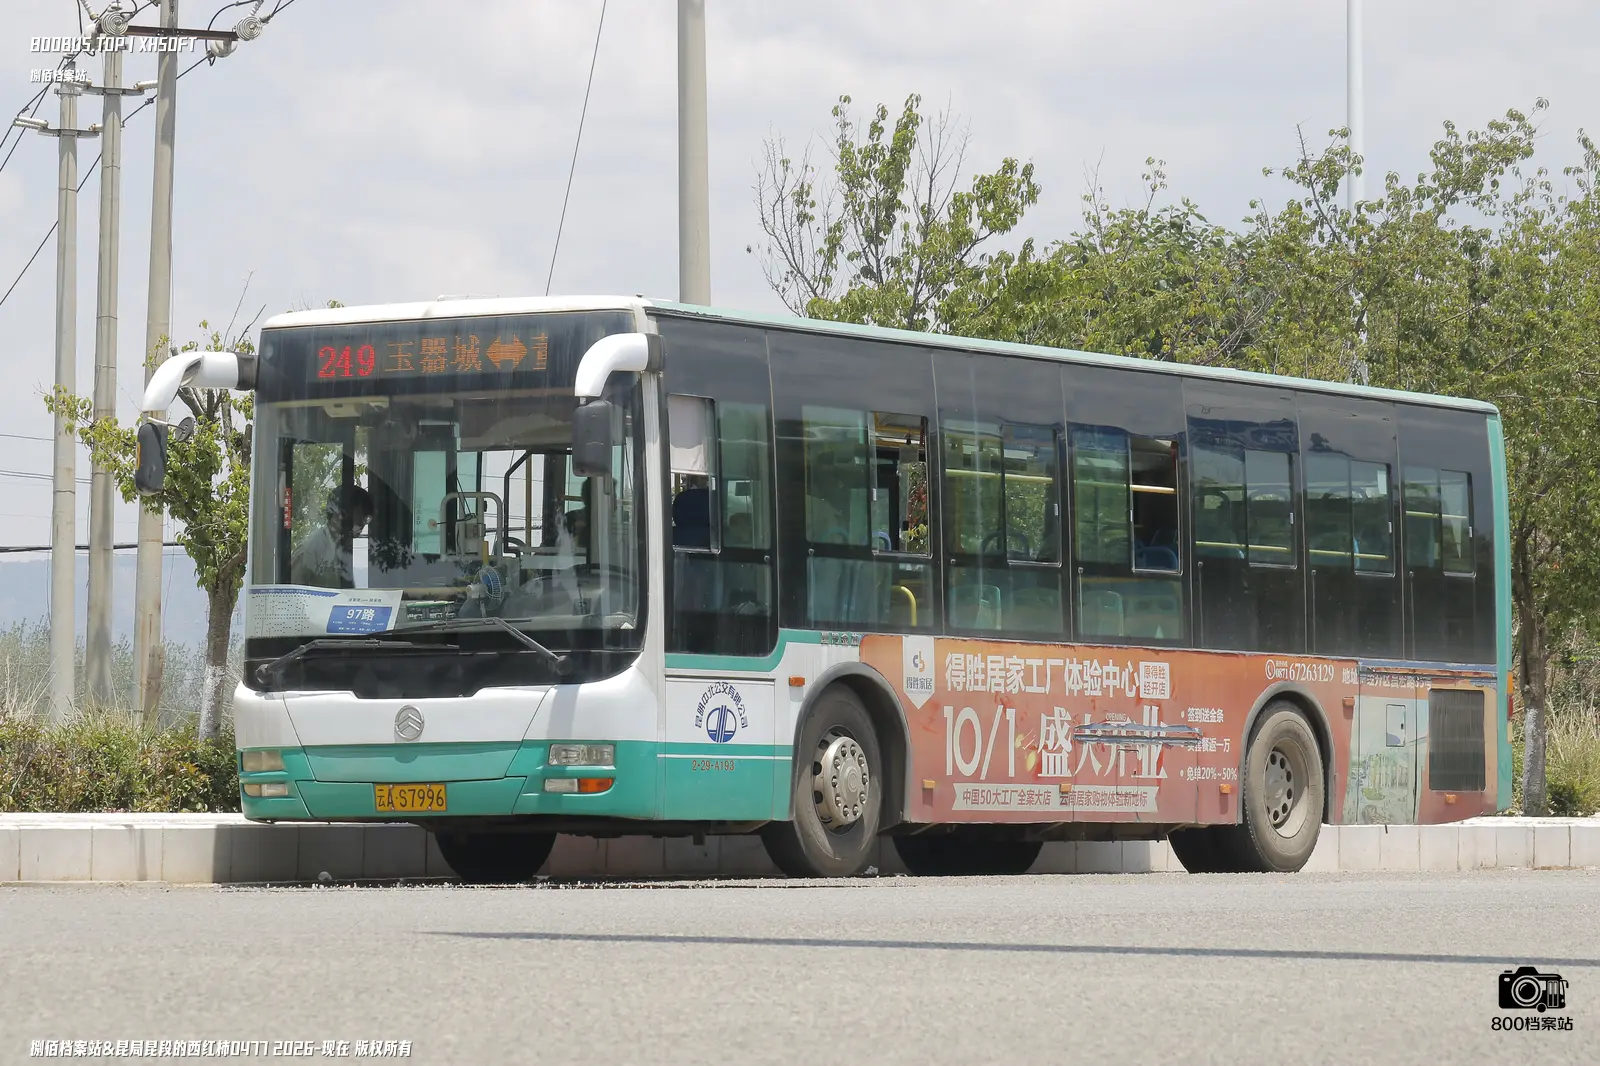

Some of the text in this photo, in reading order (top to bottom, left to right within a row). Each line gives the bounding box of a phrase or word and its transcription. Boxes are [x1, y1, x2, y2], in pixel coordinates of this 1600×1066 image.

[318, 344, 376, 378] 249
[346, 608, 375, 622] 97路
[945, 652, 1140, 698] 得胜居家工厂体验中心
[1275, 668, 1288, 678] 0871
[1289, 663, 1335, 682] 67263129
[1105, 712, 1127, 722] OPENING
[943, 704, 1015, 780] 10/1
[962, 788, 1148, 808] 中国50大工厂全案大店 云南居家购物体验新地标
